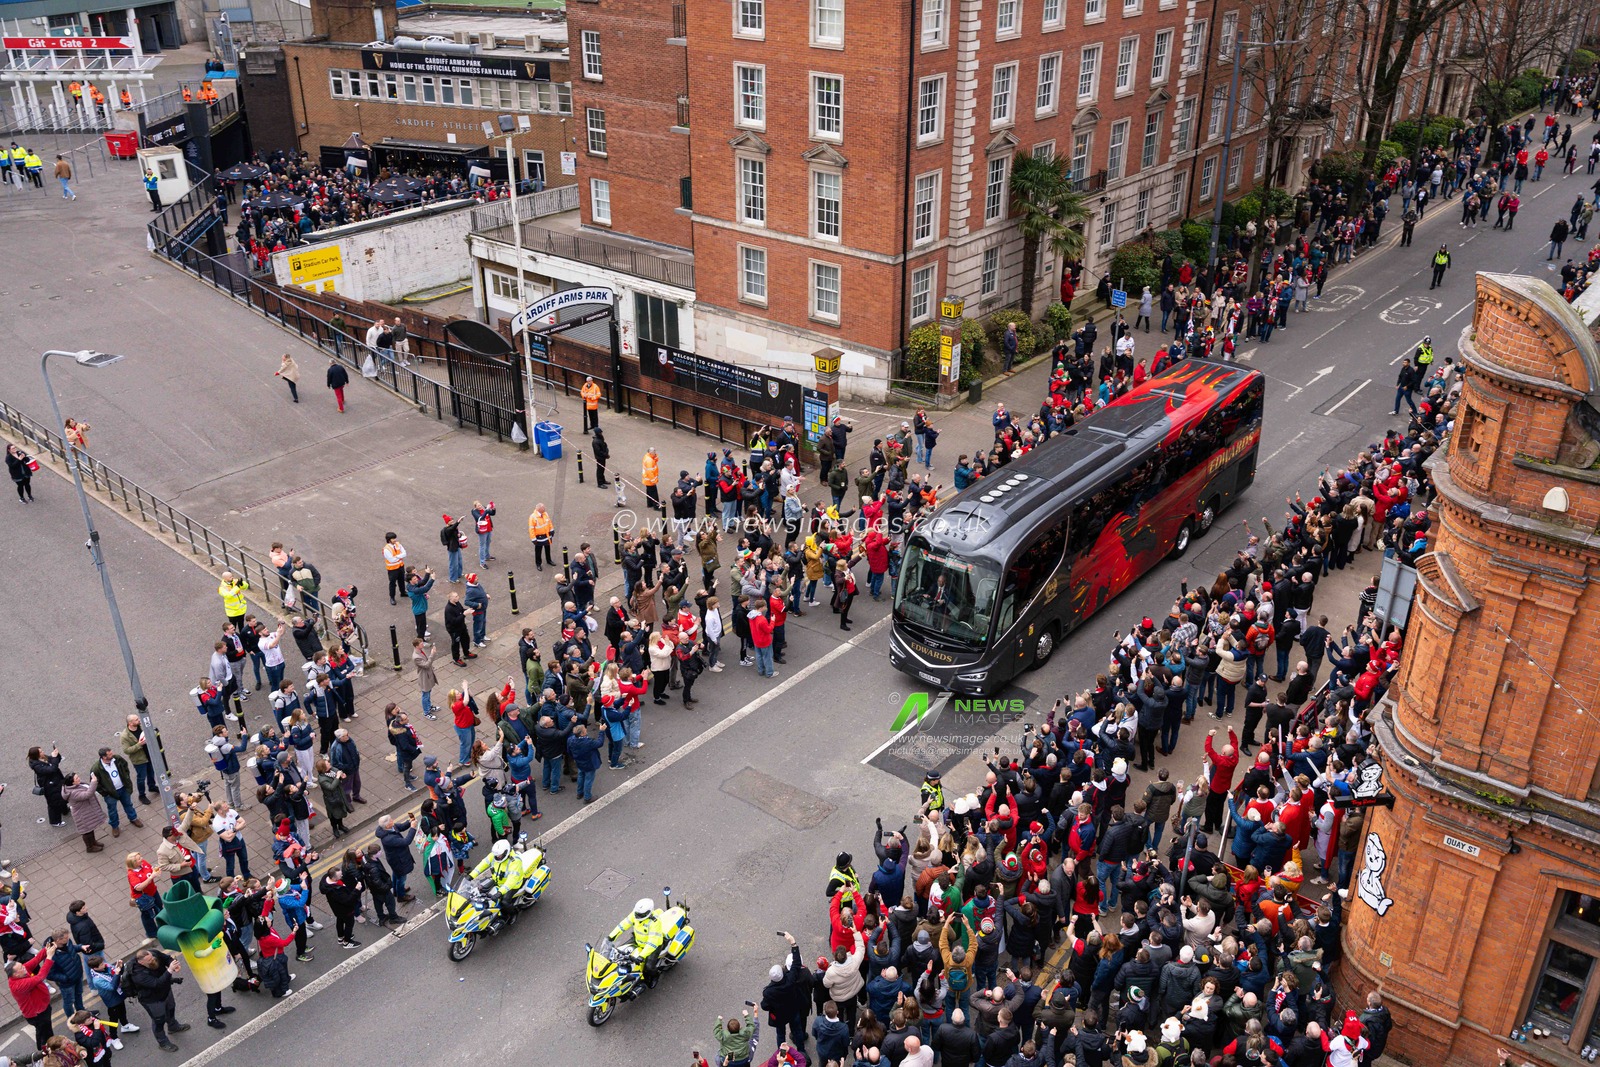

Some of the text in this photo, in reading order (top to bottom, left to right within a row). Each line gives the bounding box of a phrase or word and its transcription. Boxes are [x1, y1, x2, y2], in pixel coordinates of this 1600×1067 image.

[60, 38, 82, 48] Gate
[90, 38, 98, 48] 2
[425, 57, 448, 65] CARDIFF
[449, 58, 465, 66] ARMS
[389, 61, 406, 69] HOME
[414, 63, 425, 71] THE
[426, 64, 451, 72] OFFICIAL
[451, 66, 480, 74] GUINNESS
[481, 67, 492, 75] FAN
[493, 68, 517, 77] VILLAGE
[396, 118, 485, 131] CARDIFF ATHLETI
[518, 291, 608, 325] CARDIFF ARMS PARK
[672, 352, 697, 363] WELCOME
[707, 362, 730, 372] CARDIFF
[731, 368, 746, 377] ARMS
[747, 374, 762, 382] PARK
[911, 641, 953, 662] EDWARDS
[1446, 837, 1466, 850] QUAY
